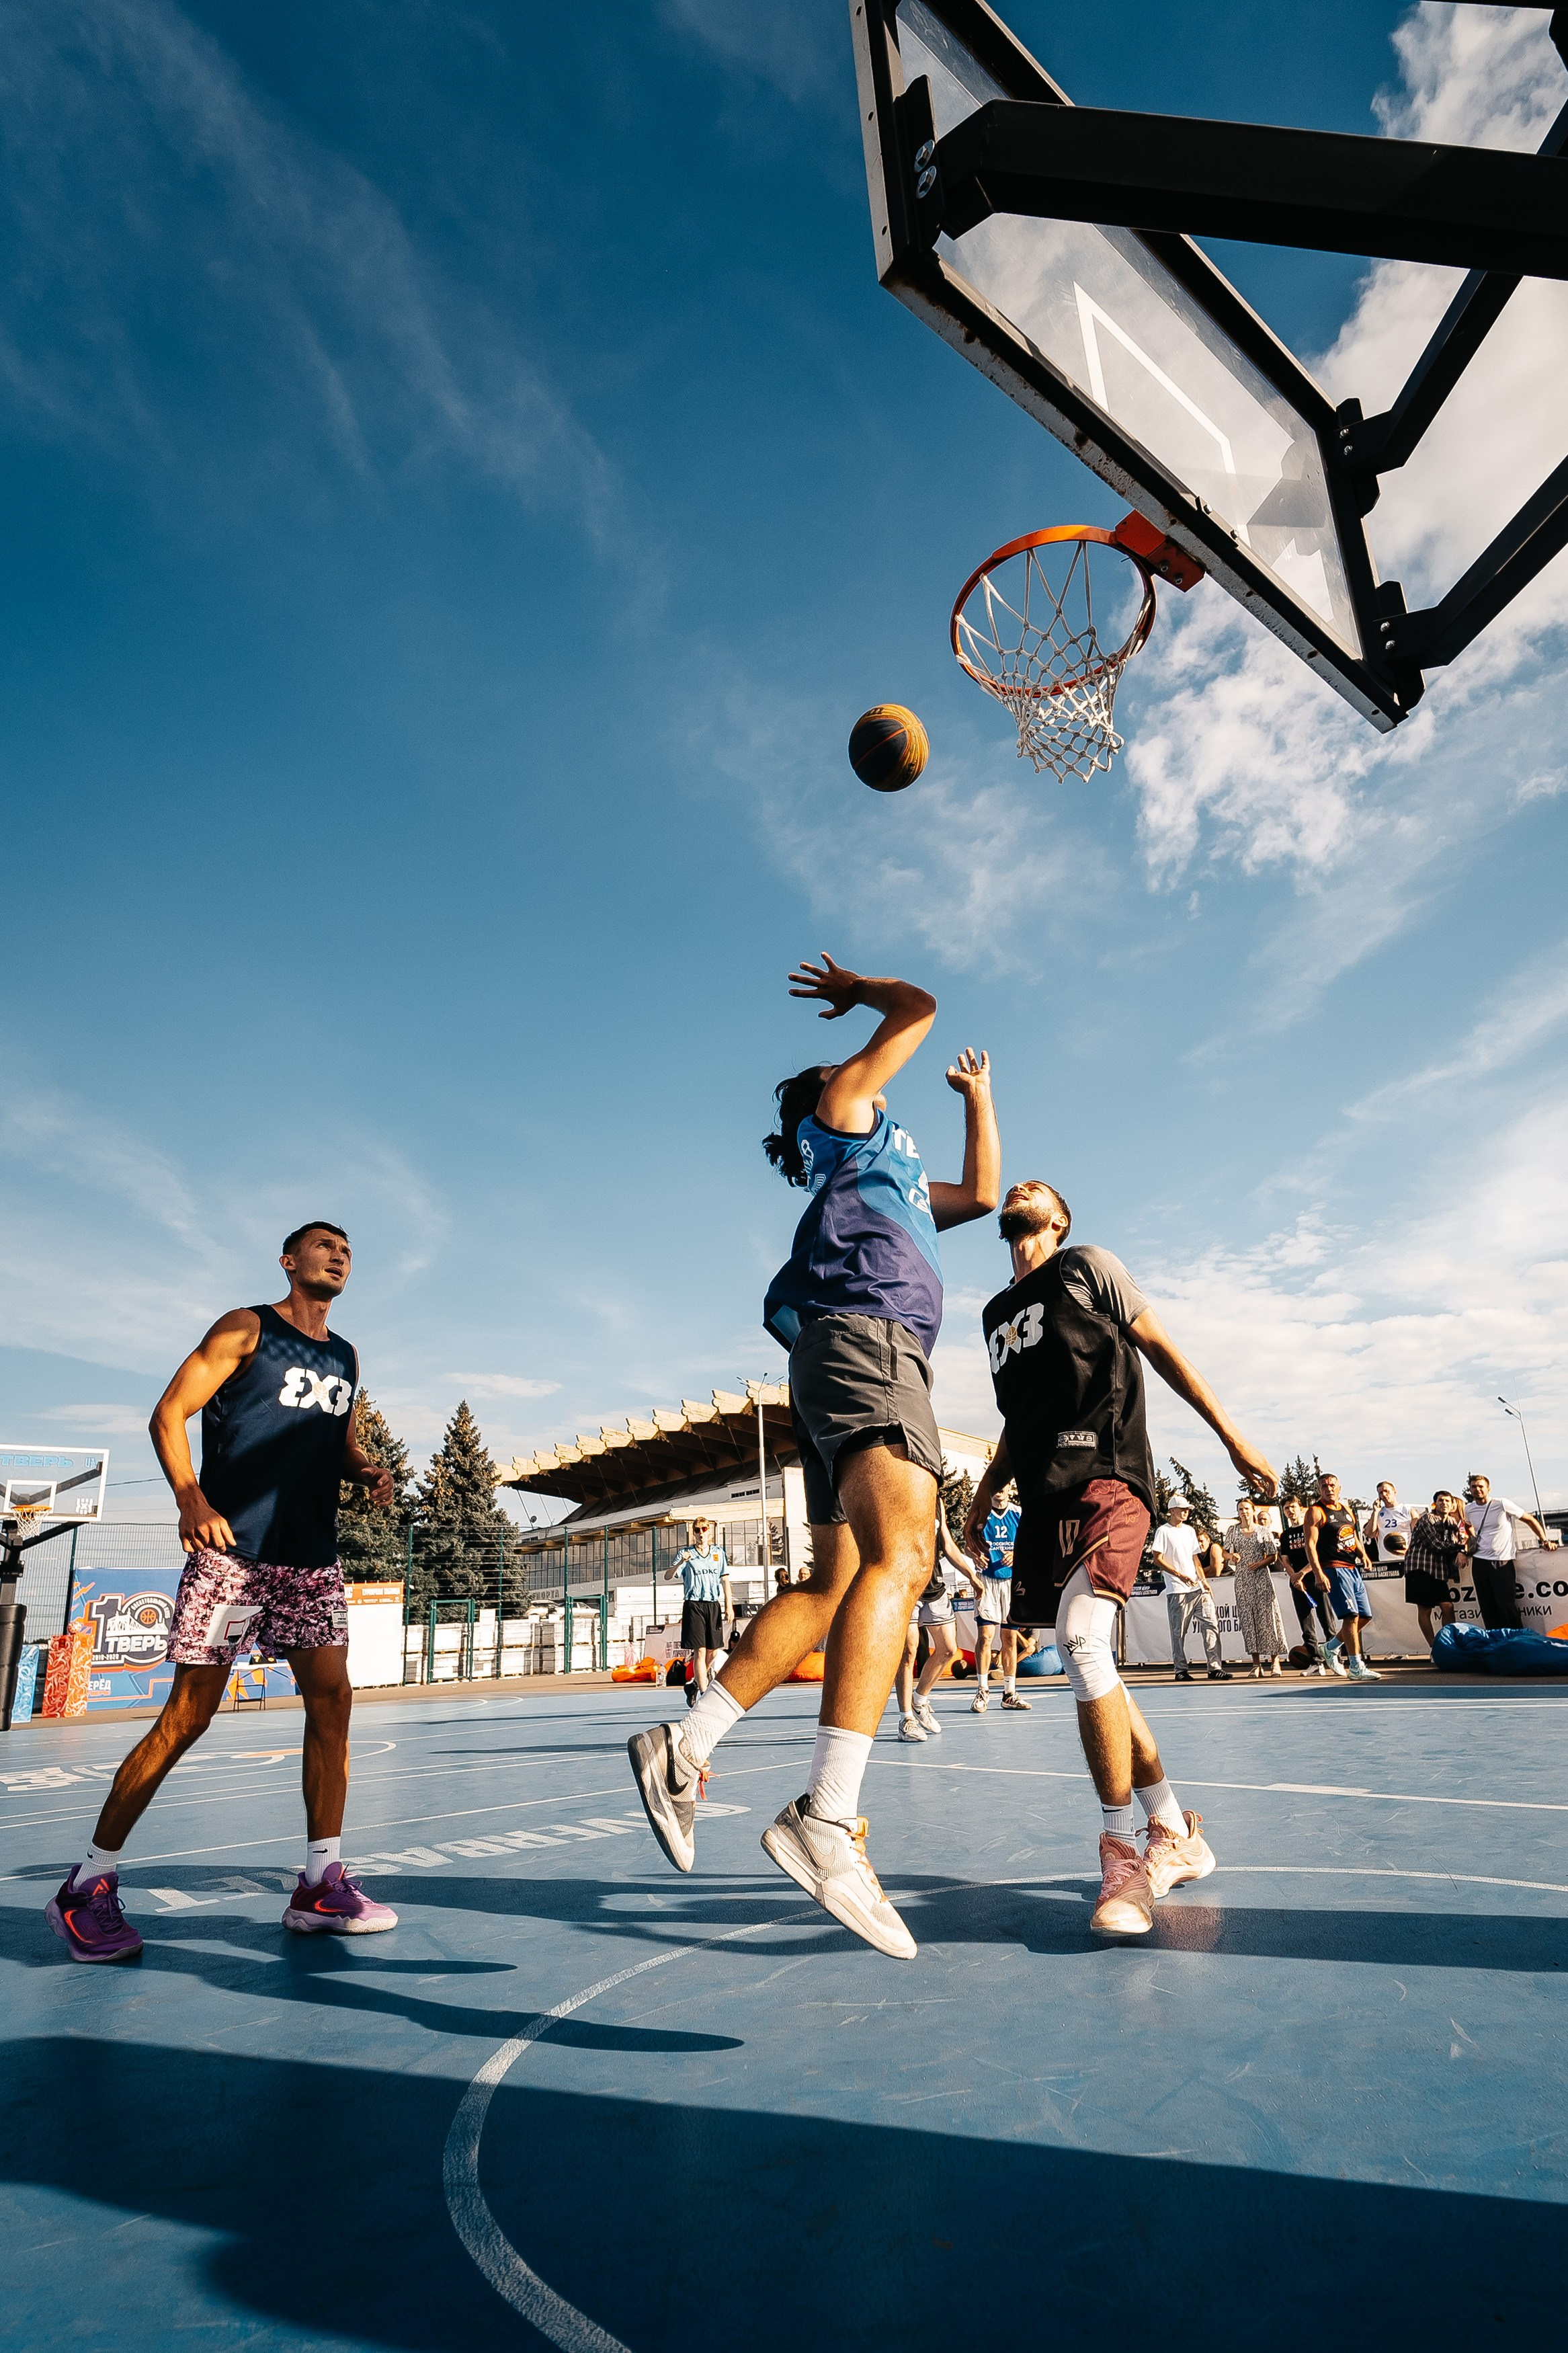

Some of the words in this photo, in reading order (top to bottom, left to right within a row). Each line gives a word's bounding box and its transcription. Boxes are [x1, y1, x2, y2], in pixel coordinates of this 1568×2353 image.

[0, 1453, 73, 1468] ТВЕРЬ
[1385, 1519, 1397, 1528] 23
[995, 1525, 1007, 1538] 12
[105, 1635, 168, 1653] ТВЕРЬ
[1063, 1634, 1086, 1657] MVP
